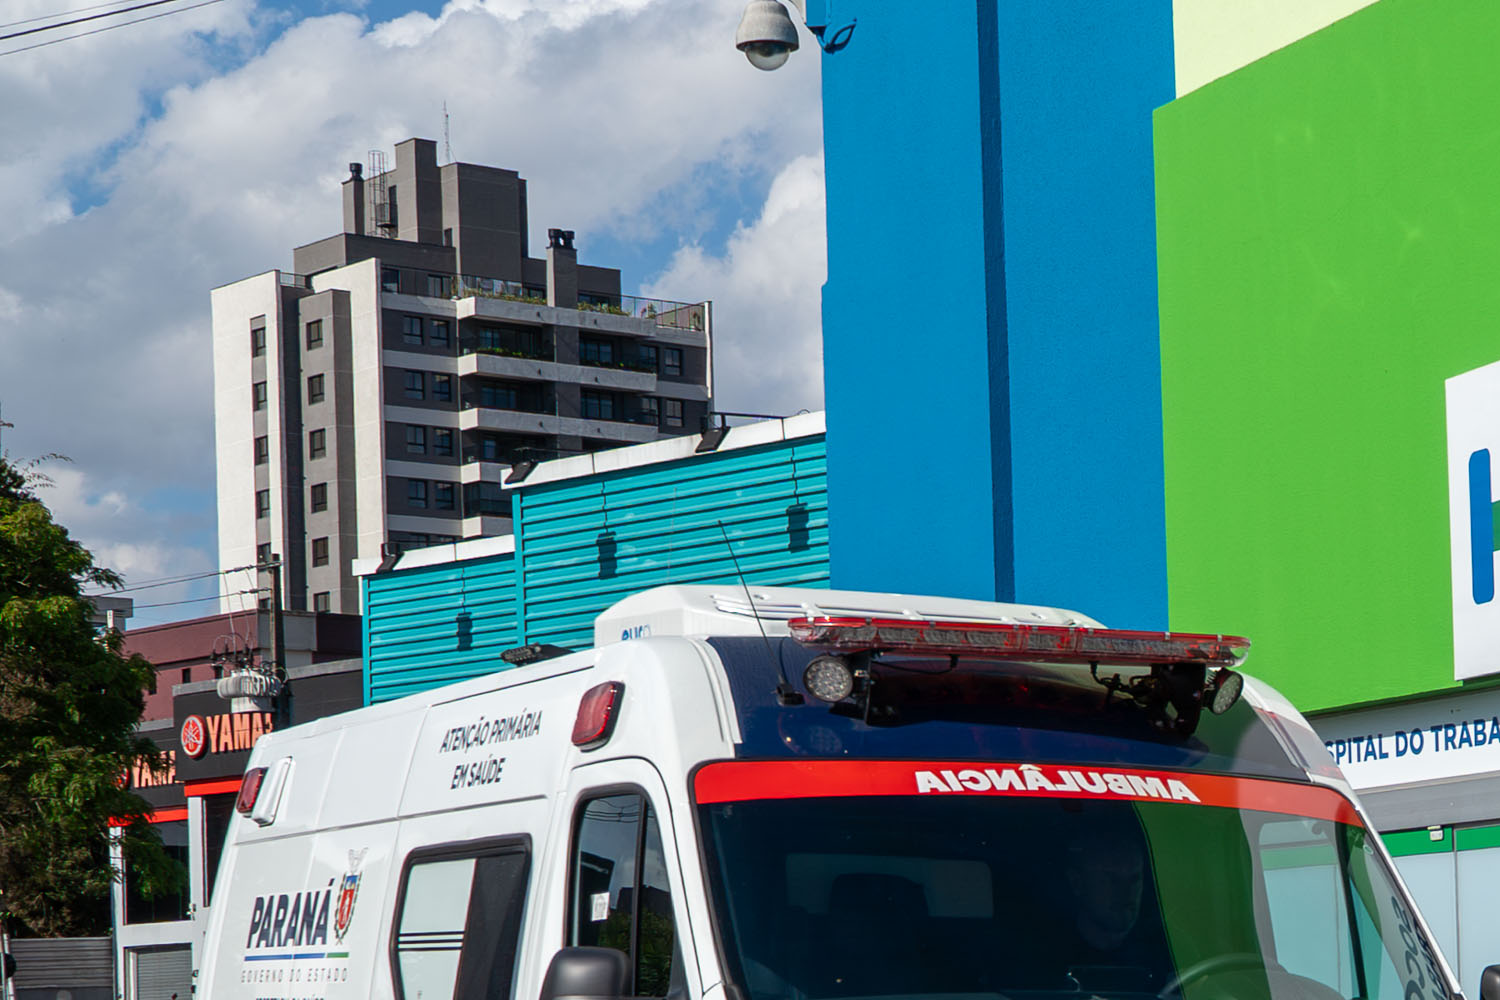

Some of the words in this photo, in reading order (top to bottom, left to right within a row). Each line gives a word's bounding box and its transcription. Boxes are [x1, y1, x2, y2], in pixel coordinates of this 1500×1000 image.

[439, 715, 490, 754] ATENÇÃO
[488, 707, 543, 745] PRIMÁRIA
[1395, 727, 1425, 757] DO
[450, 763, 470, 790] EM
[467, 753, 506, 788] SAÚDE
[246, 878, 335, 949] PARANÁ
[240, 969, 284, 983] GOVERNO
[289, 968, 302, 982] DO
[307, 967, 348, 982] ESTADO
